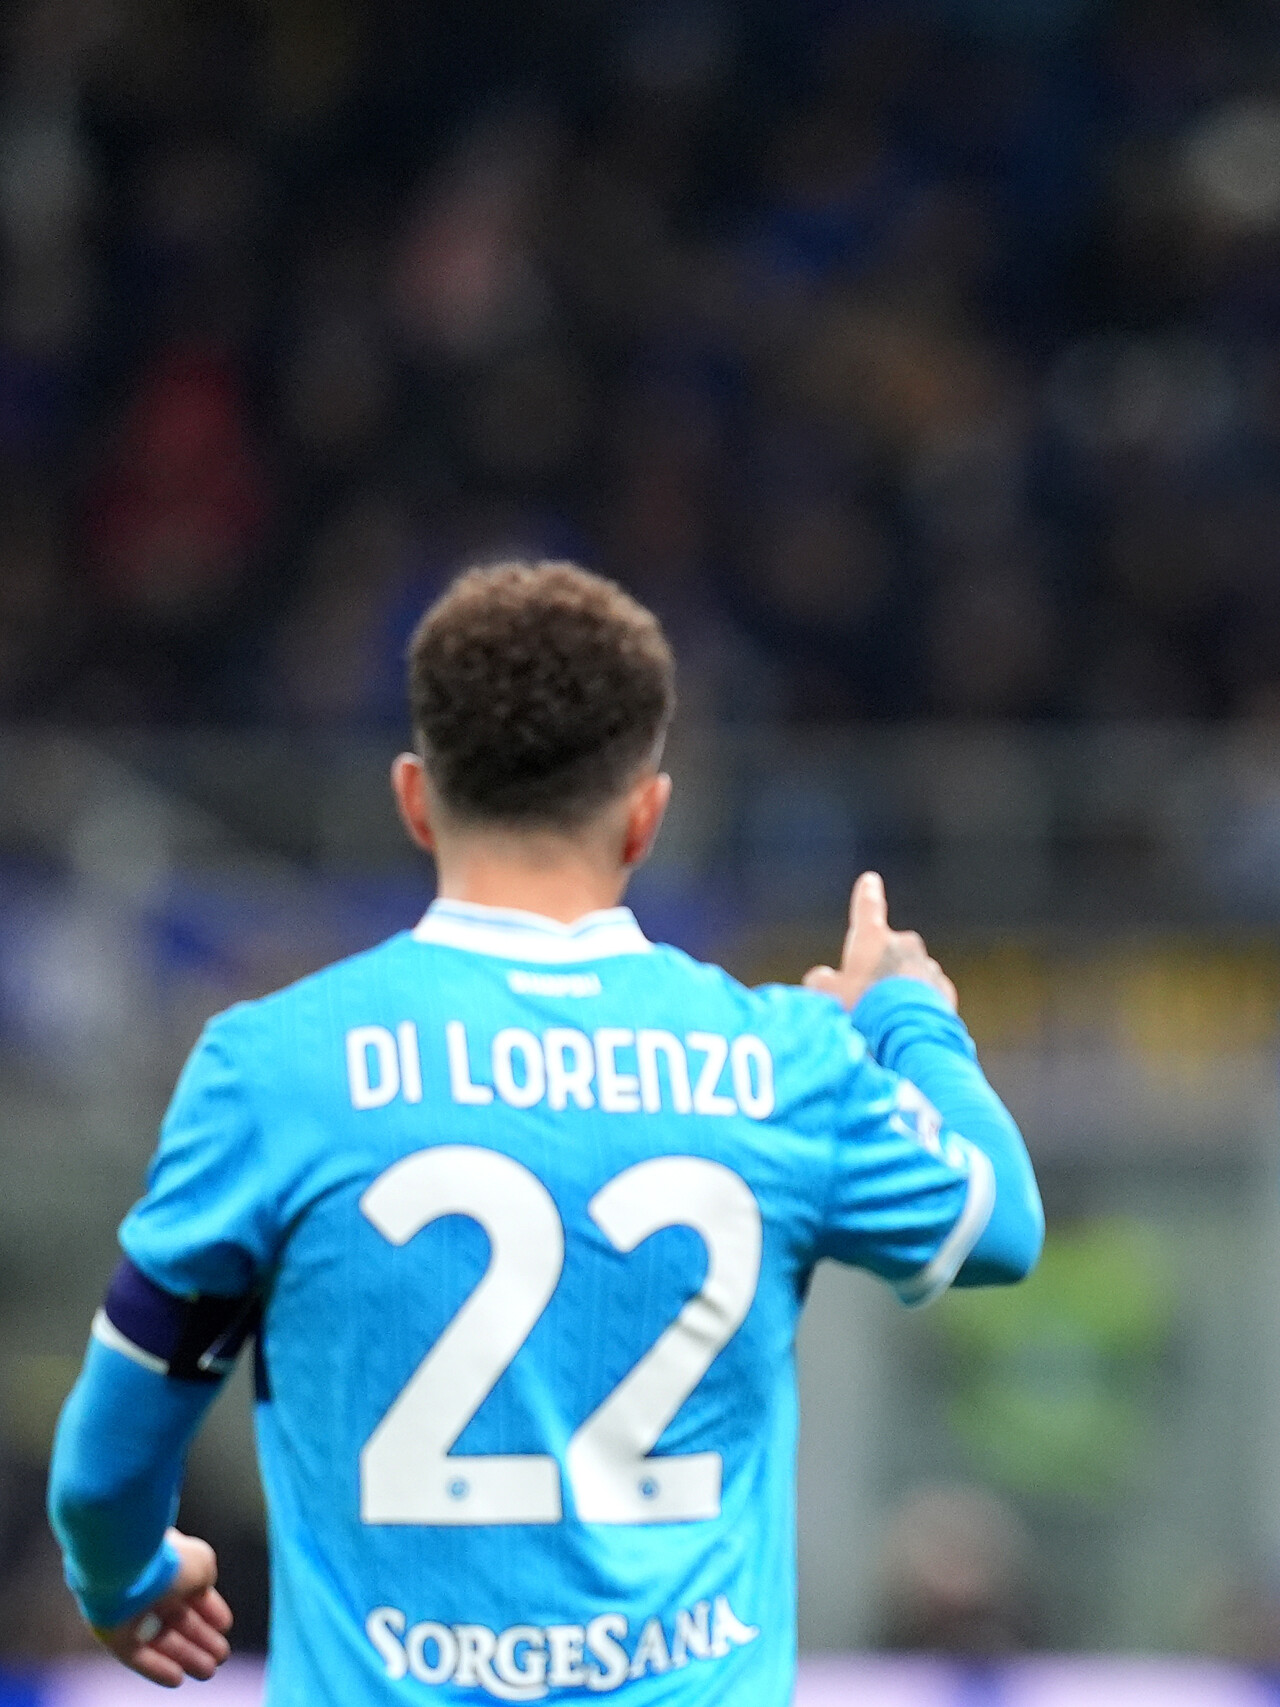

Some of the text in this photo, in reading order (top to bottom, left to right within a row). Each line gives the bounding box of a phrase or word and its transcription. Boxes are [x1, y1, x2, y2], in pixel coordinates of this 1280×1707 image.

[345, 1019, 776, 1121] DI LORENZO
[358, 1144, 764, 1526] 22
[364, 1594, 761, 1700] SORGESANA
